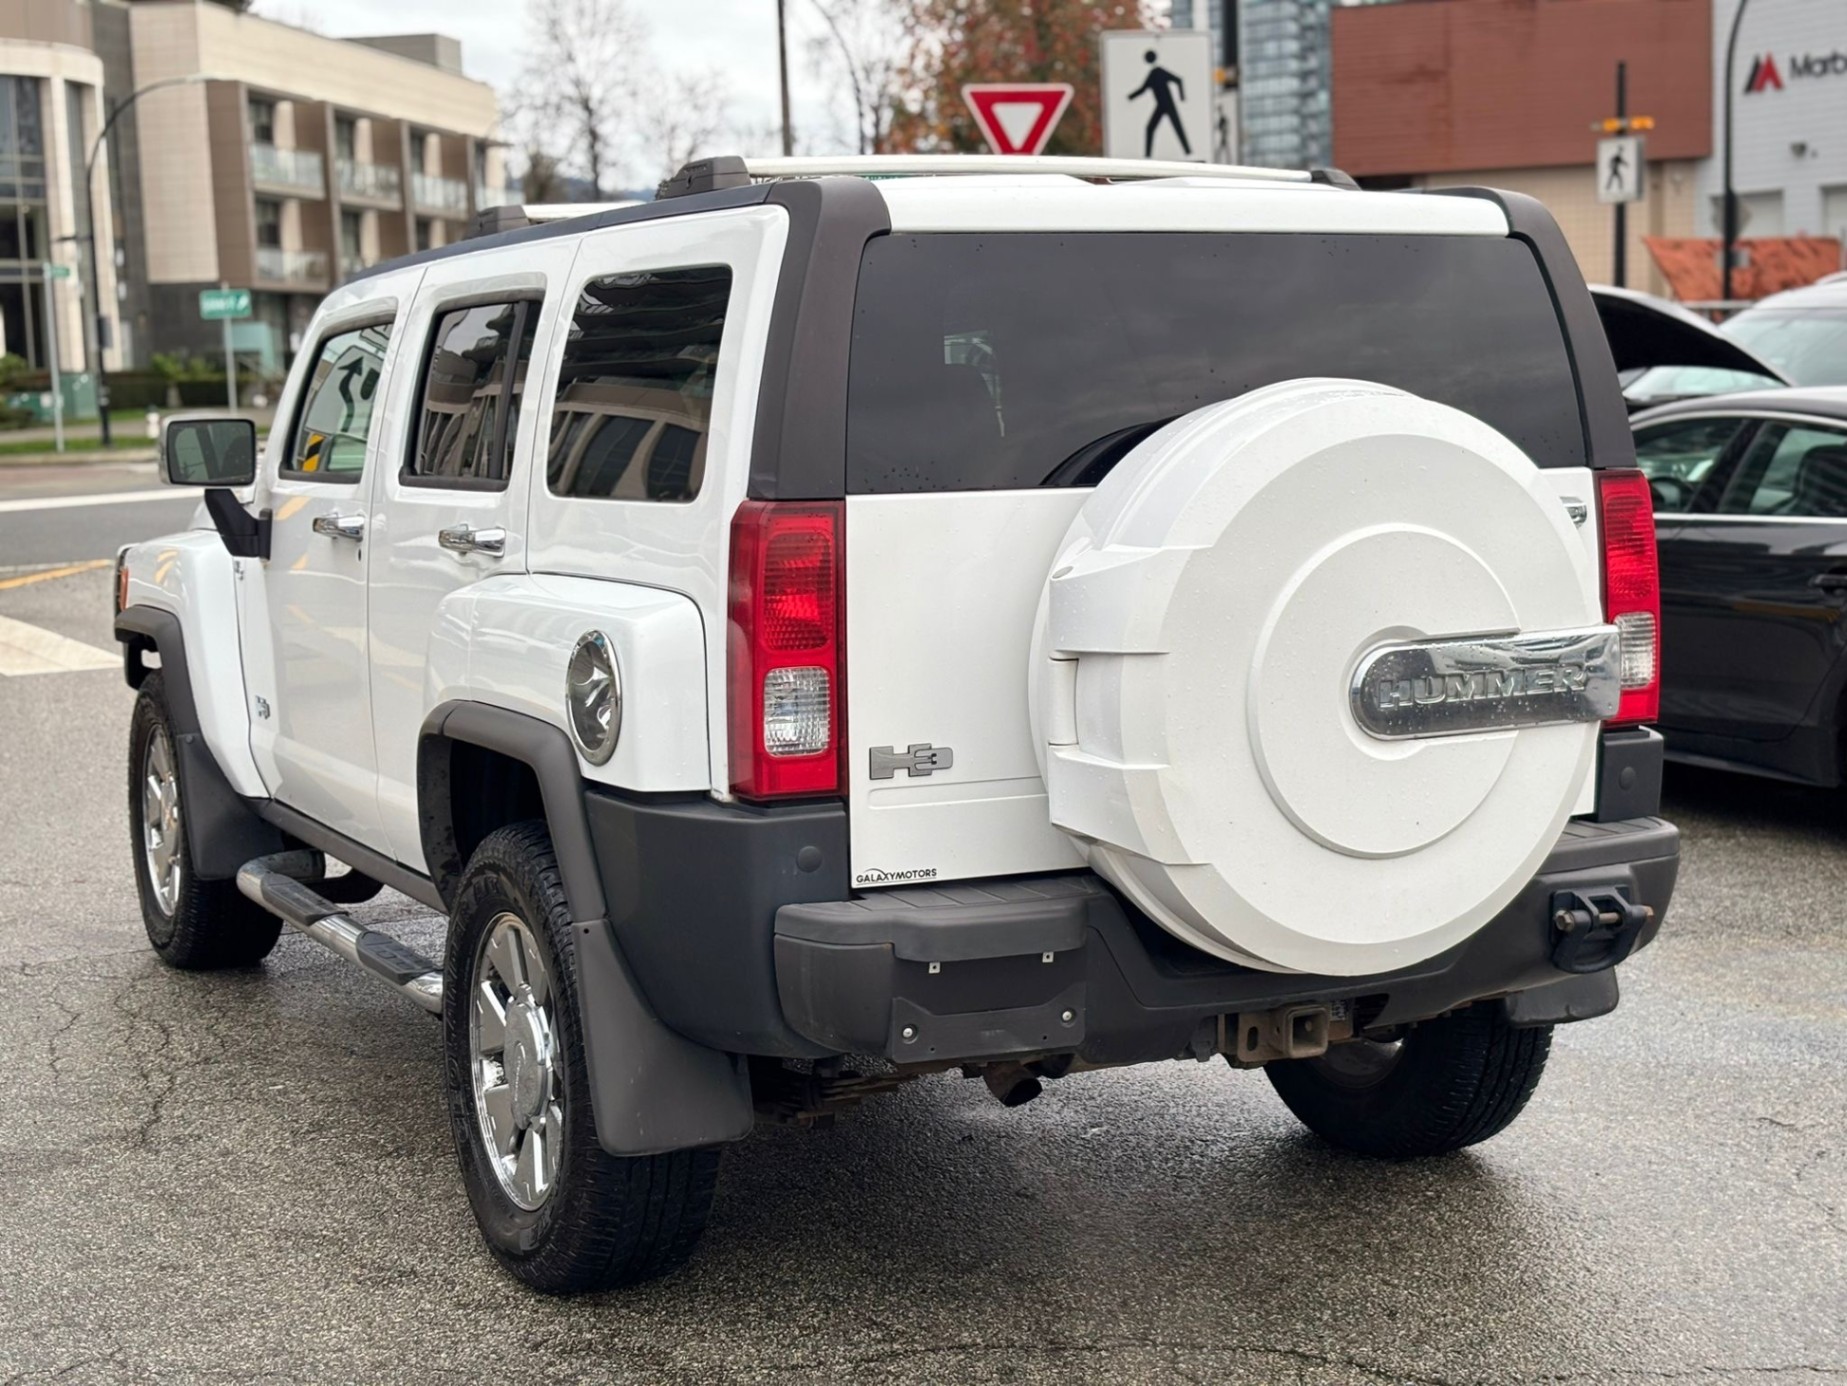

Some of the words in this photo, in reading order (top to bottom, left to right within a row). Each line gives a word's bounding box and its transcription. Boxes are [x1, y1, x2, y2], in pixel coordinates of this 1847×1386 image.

[1378, 663, 1588, 708] HUMMER
[869, 743, 953, 780] H3
[856, 868, 937, 884] GALAXYMOTORS
